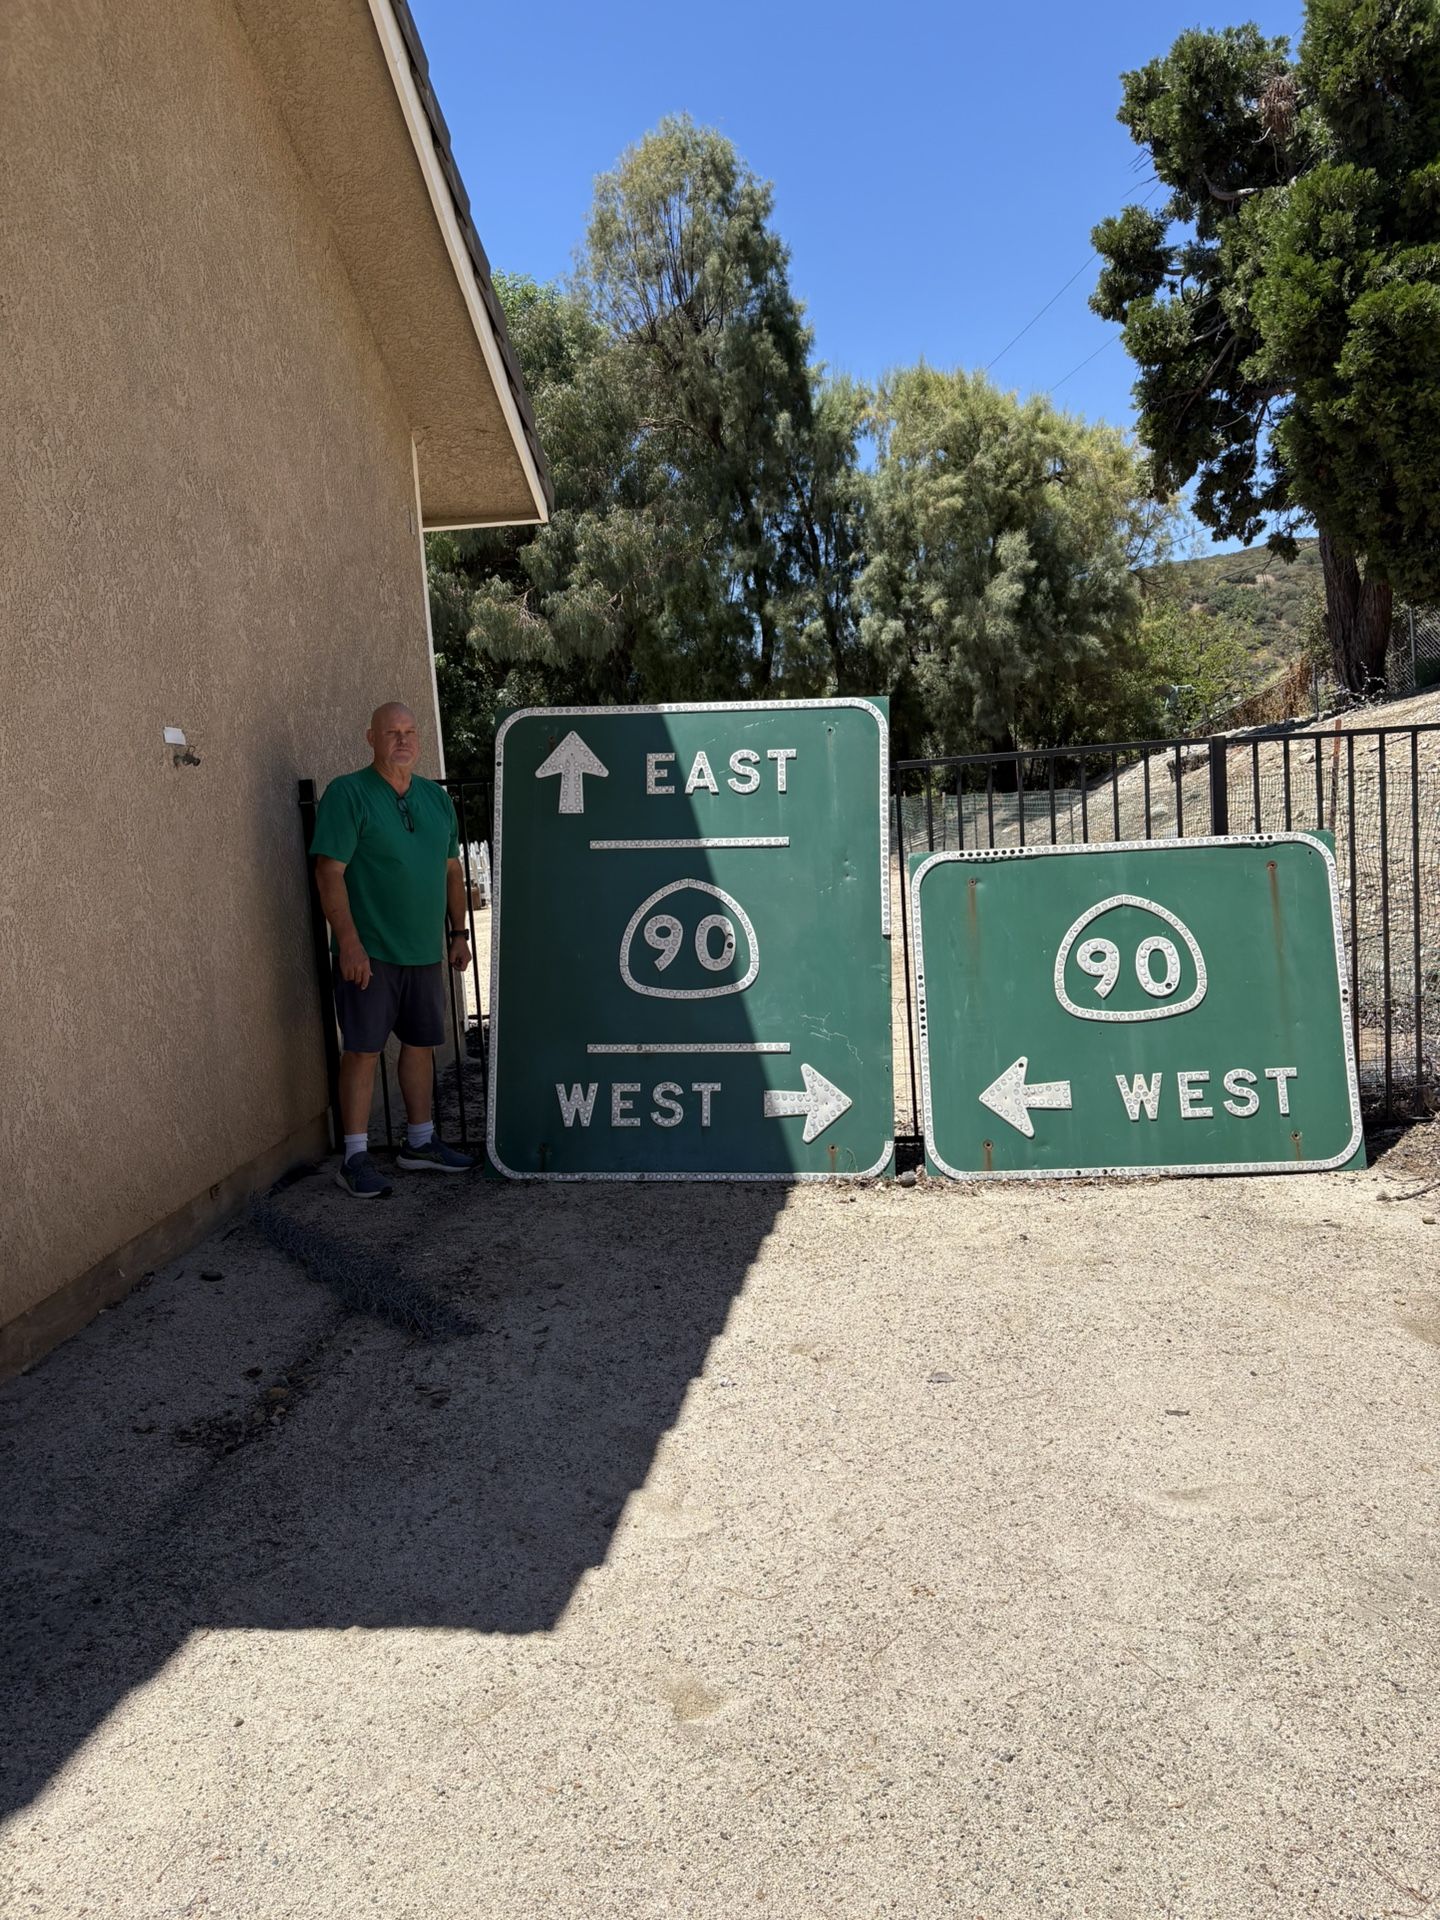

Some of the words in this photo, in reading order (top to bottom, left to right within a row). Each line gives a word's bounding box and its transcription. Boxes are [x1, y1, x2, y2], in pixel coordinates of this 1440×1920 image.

[646, 749, 797, 795] EAST
[643, 914, 737, 971] 90
[1076, 935, 1181, 999] 90
[555, 1081, 721, 1127] WEST
[1115, 1067, 1298, 1121] WEST
